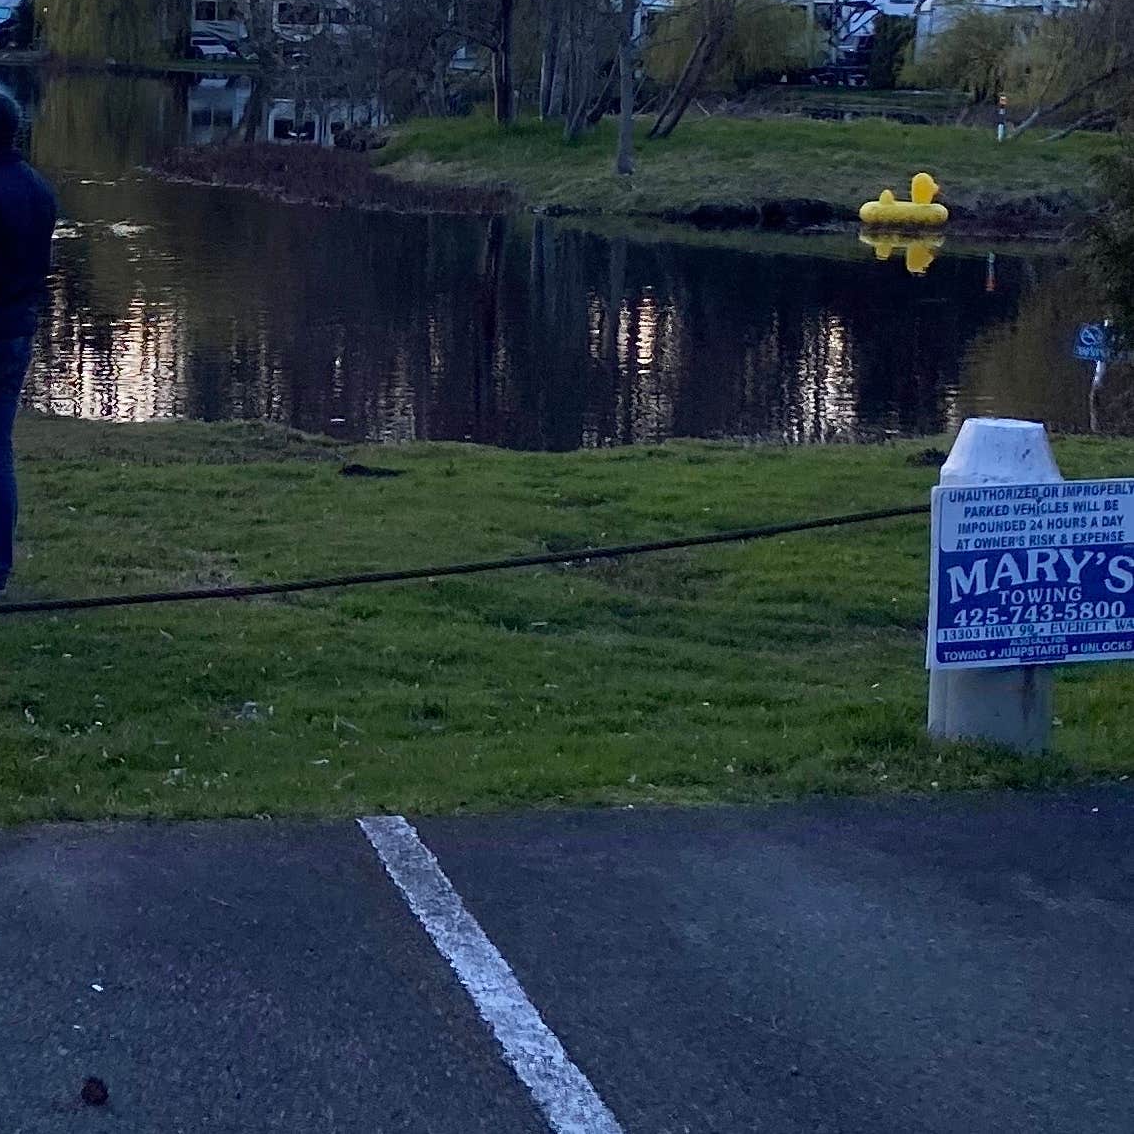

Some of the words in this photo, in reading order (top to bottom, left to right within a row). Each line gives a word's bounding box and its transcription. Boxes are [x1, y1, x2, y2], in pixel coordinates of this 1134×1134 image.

[949, 487, 1039, 503] UNAUTHORIZED
[1043, 487, 1058, 499] OR
[1062, 483, 1134, 498] IMPROPERLY
[964, 504, 1009, 518] PARKED
[1013, 502, 1068, 516] VEHICLES
[1073, 501, 1100, 513] WILL
[1103, 499, 1119, 511] BE
[958, 520, 1026, 534] IMPOUNDED
[1029, 519, 1043, 531] 24
[1047, 516, 1087, 530] HOURS
[1091, 516, 1098, 528] A
[1102, 515, 1124, 527] DAY
[956, 538, 970, 550] AT
[974, 534, 1025, 548] OWNER'S
[1029, 533, 1055, 546] RISK
[1060, 533, 1068, 545] &
[1073, 531, 1125, 544] EXPENSE
[946, 548, 1134, 605] MARY'S
[998, 586, 1082, 605] TOWING
[954, 600, 1126, 627] 425-743-5800
[943, 628, 981, 641] 13303
[984, 626, 1016, 639] HWY
[1019, 624, 1035, 636] 99
[1050, 619, 1107, 633] EVERETT
[943, 650, 987, 661] TOWING
[998, 644, 1069, 657] JUMPSTARTS
[1080, 640, 1133, 653] UNLOCKS
